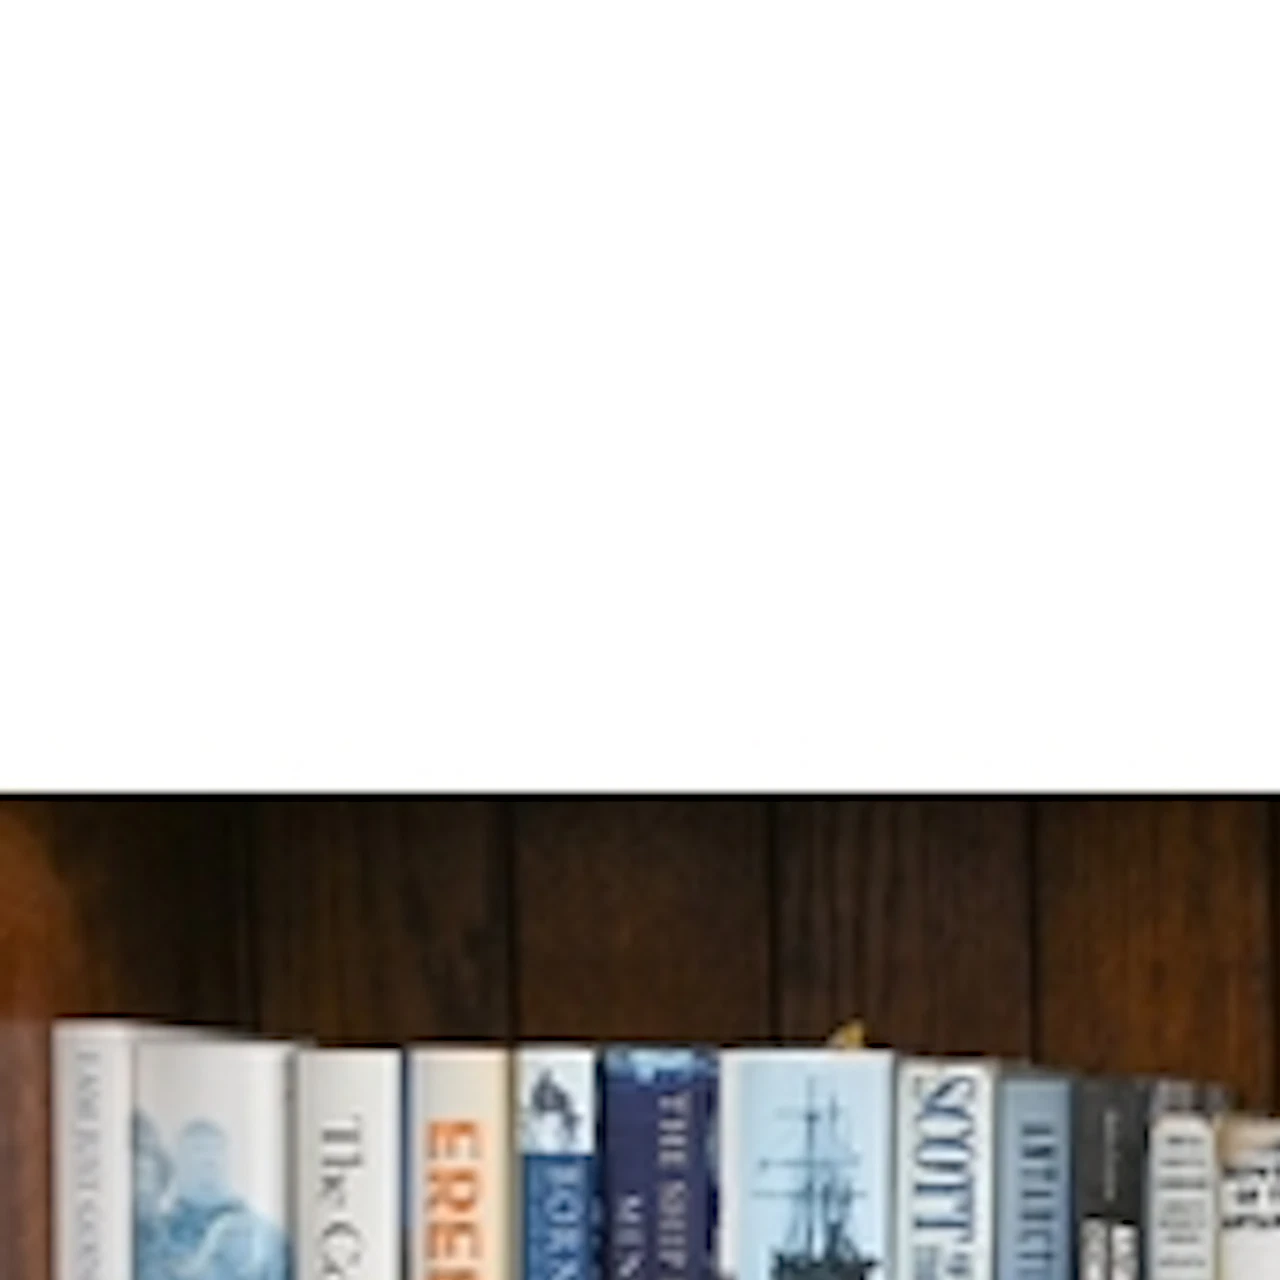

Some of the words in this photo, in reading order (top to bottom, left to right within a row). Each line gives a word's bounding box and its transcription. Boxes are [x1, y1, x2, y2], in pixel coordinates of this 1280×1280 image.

[314, 1114, 366, 1206] The
[658, 1093, 690, 1166] THE
[912, 1076, 975, 1243] SCOTT
[657, 1180, 689, 1268] SHIP
